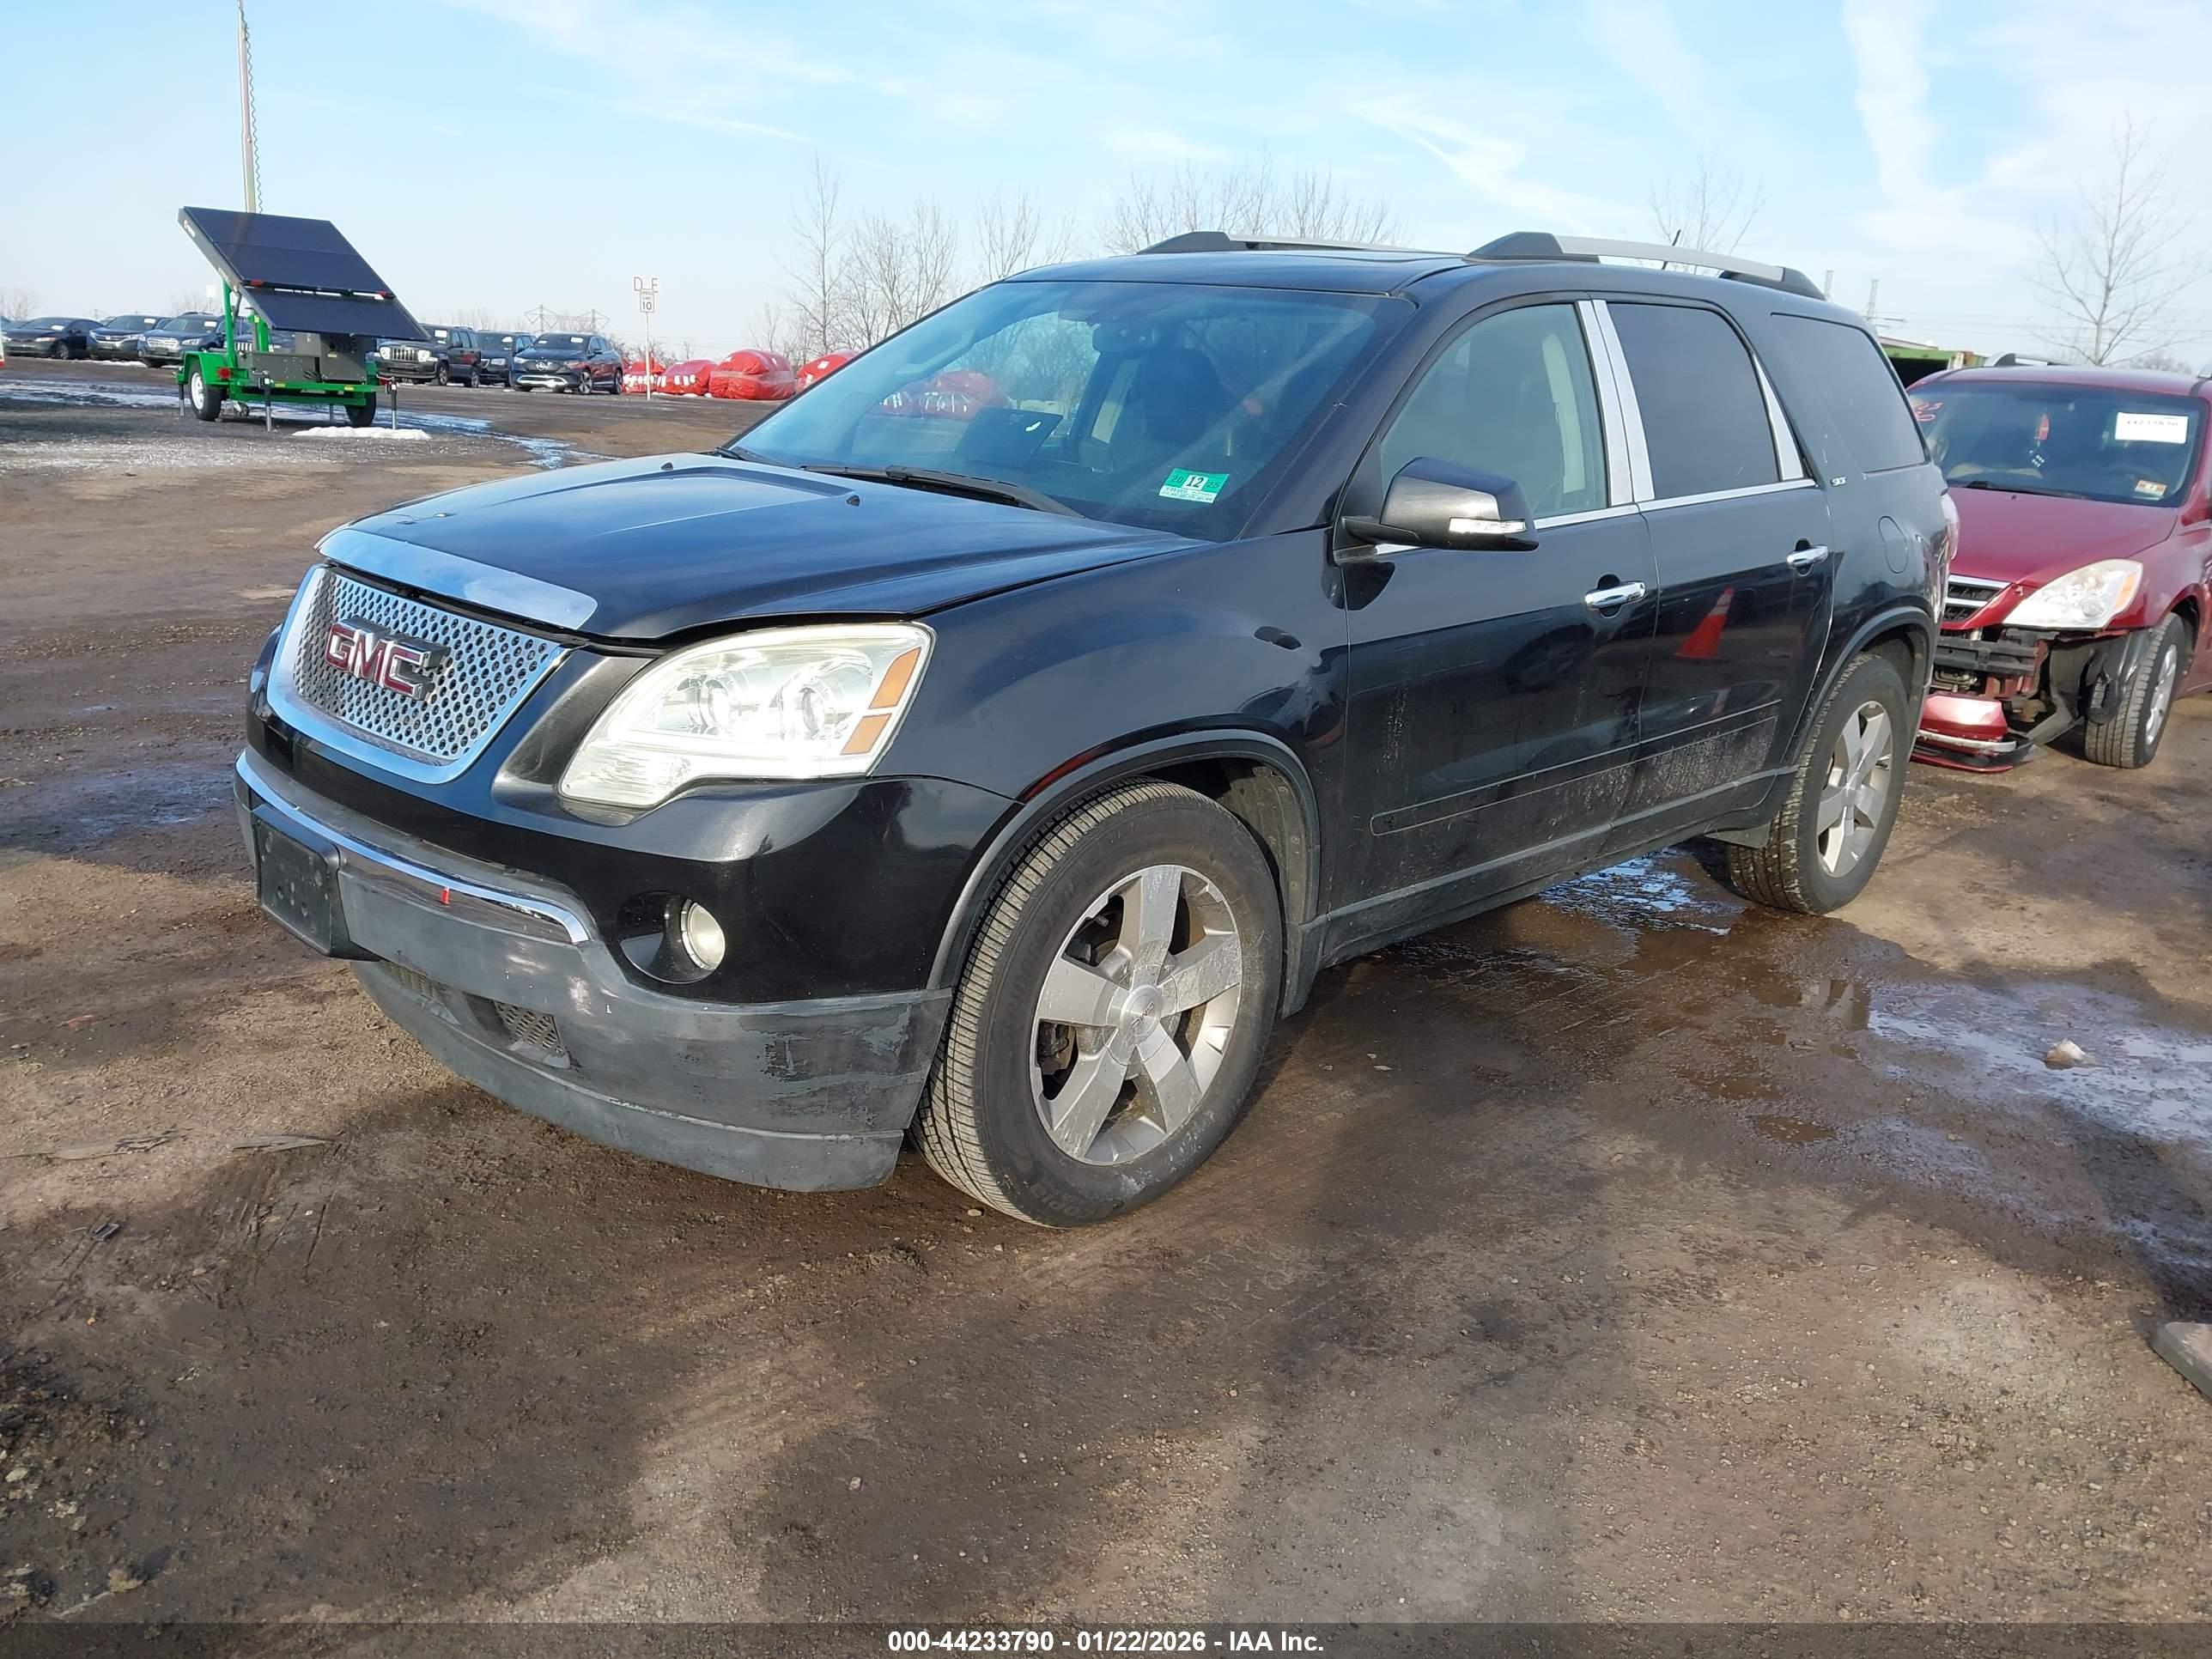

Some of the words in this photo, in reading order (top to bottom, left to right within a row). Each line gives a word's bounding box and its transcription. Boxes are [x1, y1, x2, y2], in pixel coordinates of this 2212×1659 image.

[634, 276, 643, 291] D
[642, 301, 653, 310] 10
[1186, 477, 1205, 488] 12
[325, 622, 431, 701] GMC
